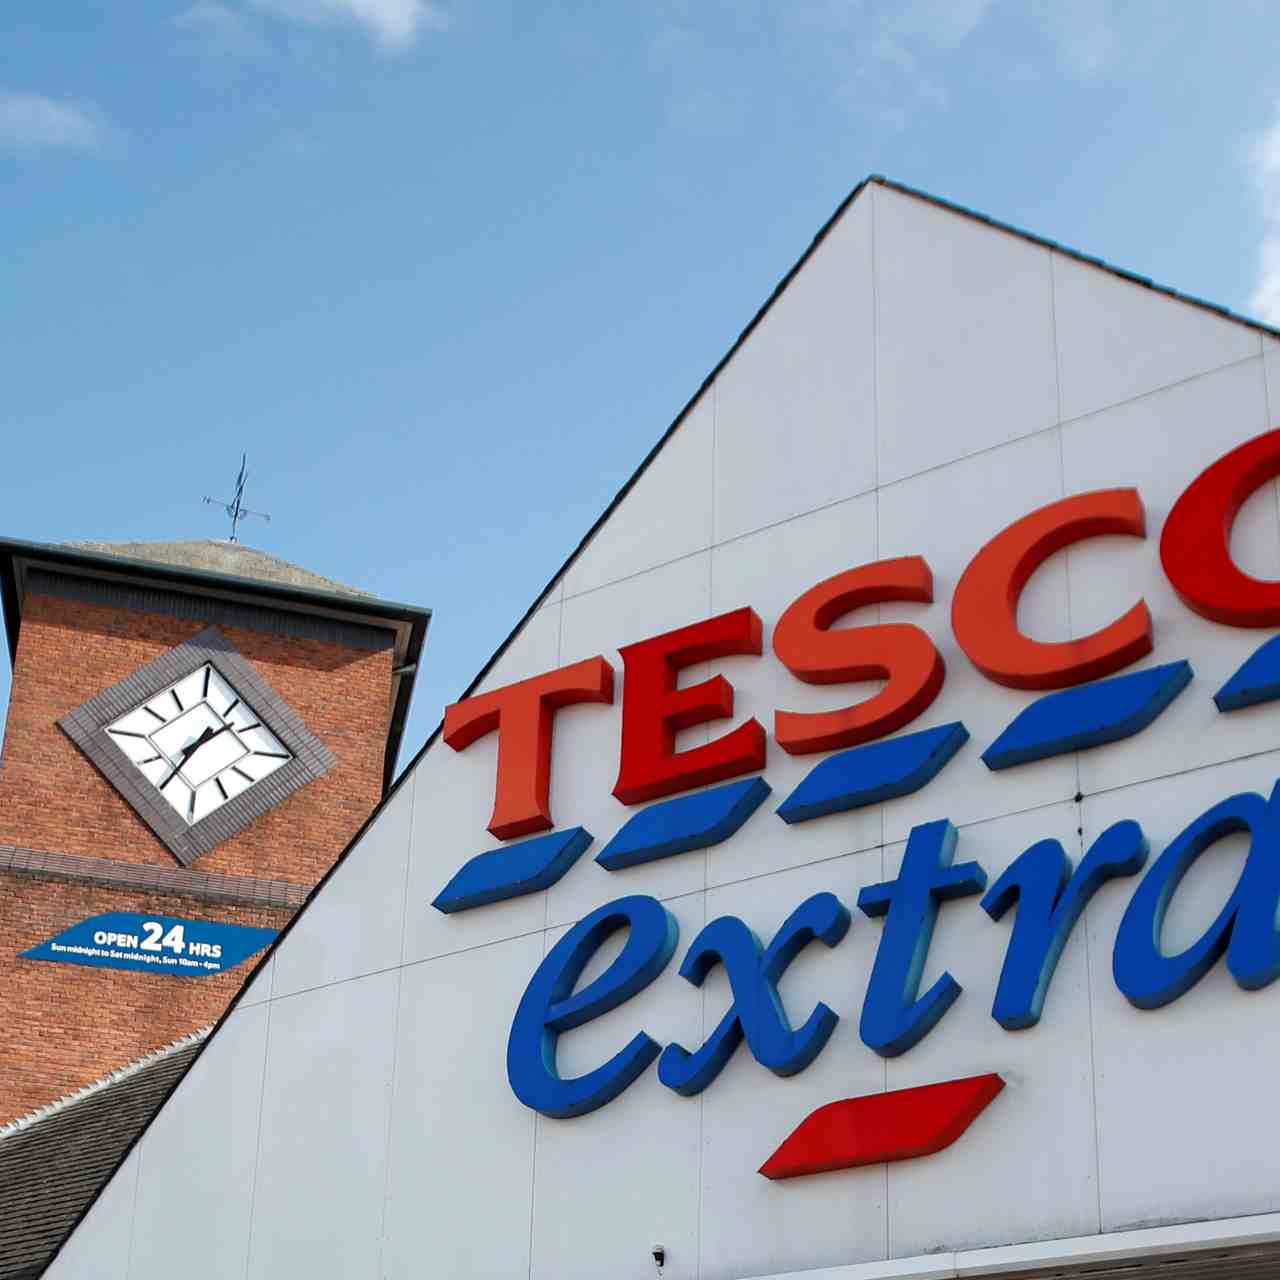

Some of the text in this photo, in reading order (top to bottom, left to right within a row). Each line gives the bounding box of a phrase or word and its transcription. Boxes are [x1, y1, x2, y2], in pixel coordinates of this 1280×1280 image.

[94, 922, 222, 958] OPEN 24 HRS
[51, 942, 67, 952] Sun
[67, 944, 100, 957] midnight
[101, 949, 109, 957] to
[110, 950, 123, 959] Sat
[163, 955, 177, 965] Sun
[178, 957, 198, 968] 10am
[203, 960, 221, 971] 4pm
